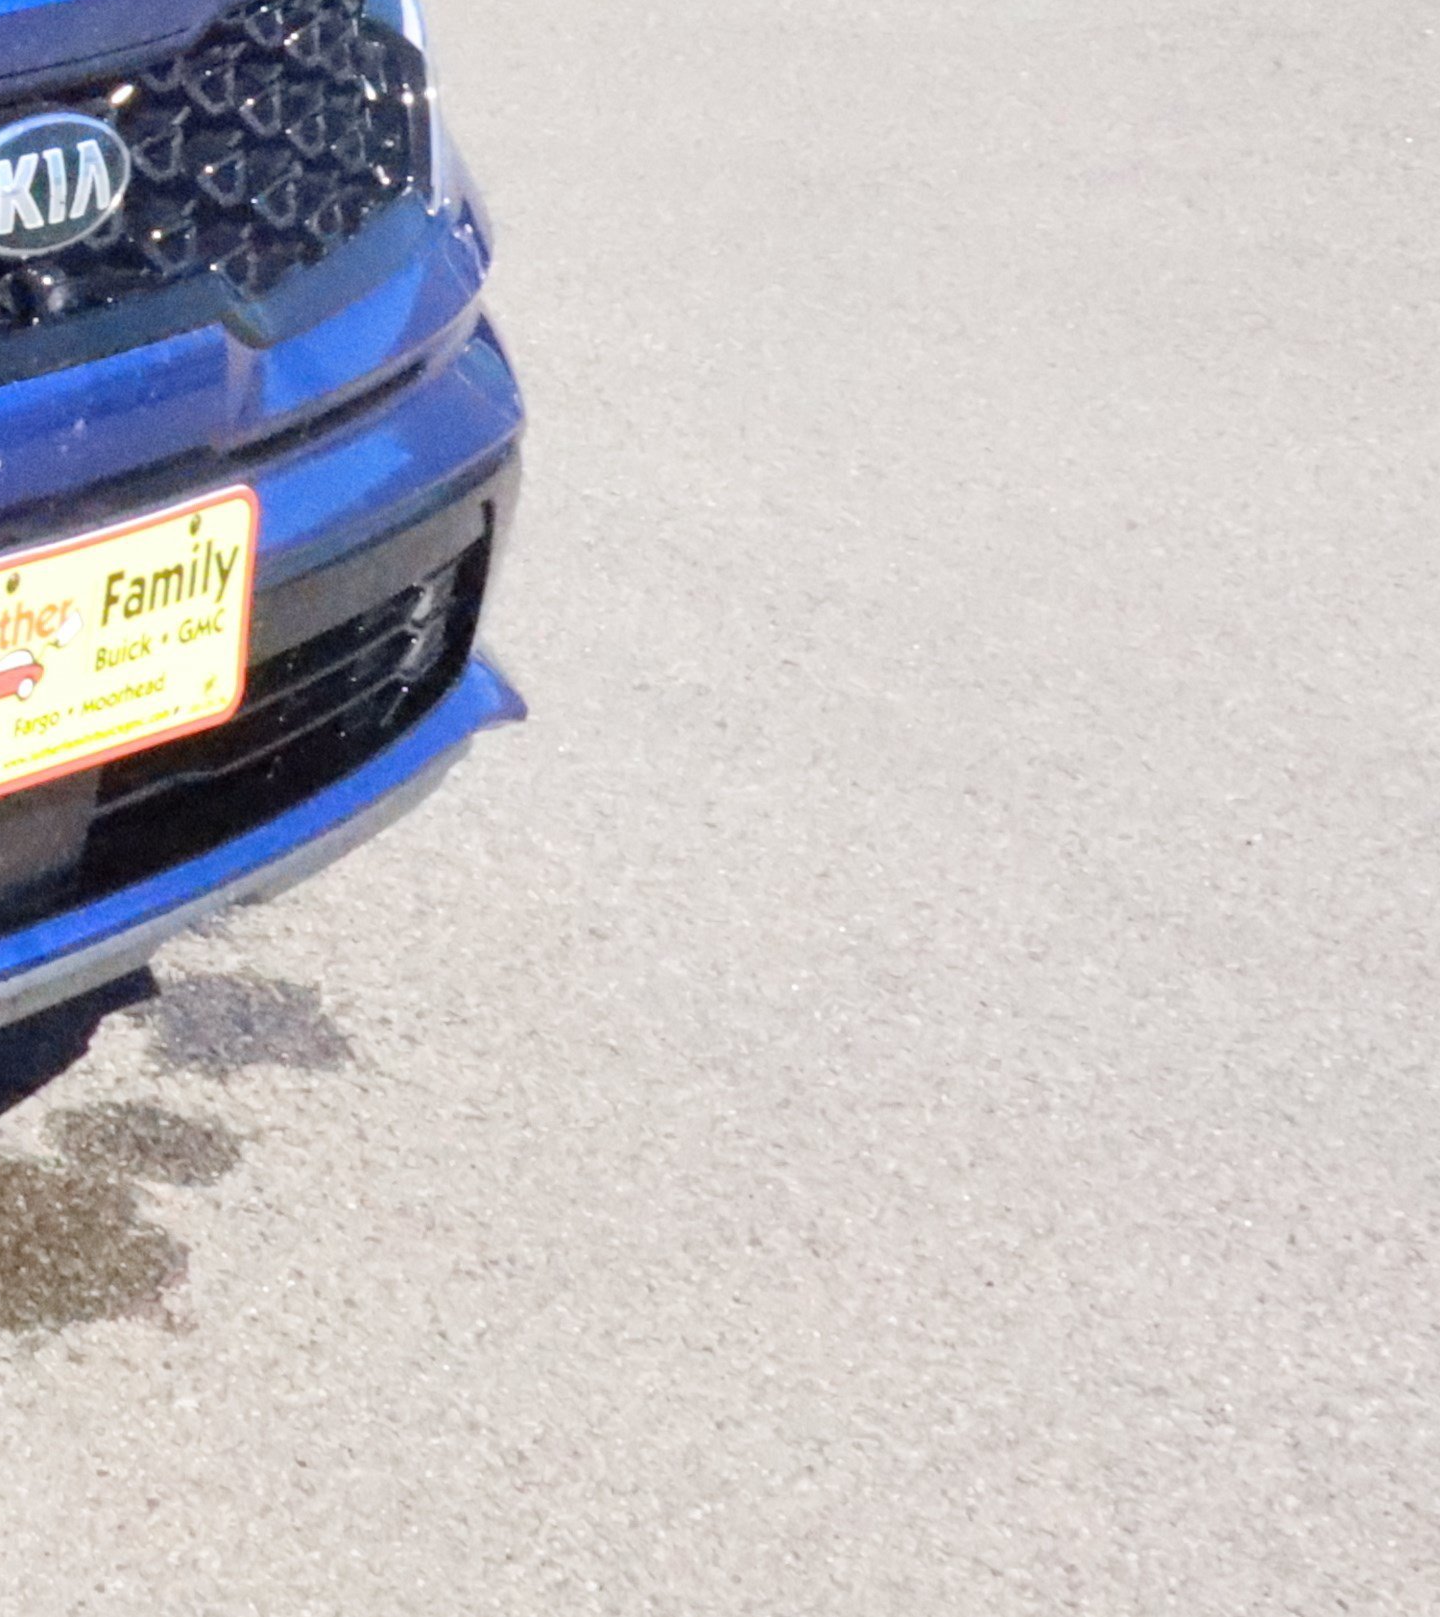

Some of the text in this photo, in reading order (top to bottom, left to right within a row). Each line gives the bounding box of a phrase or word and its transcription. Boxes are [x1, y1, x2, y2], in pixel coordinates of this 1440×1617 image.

[100, 540, 240, 628] Family
[94, 608, 226, 673] Buick GMC
[14, 711, 61, 738] Fargo
[81, 675, 166, 716] Moorhead
